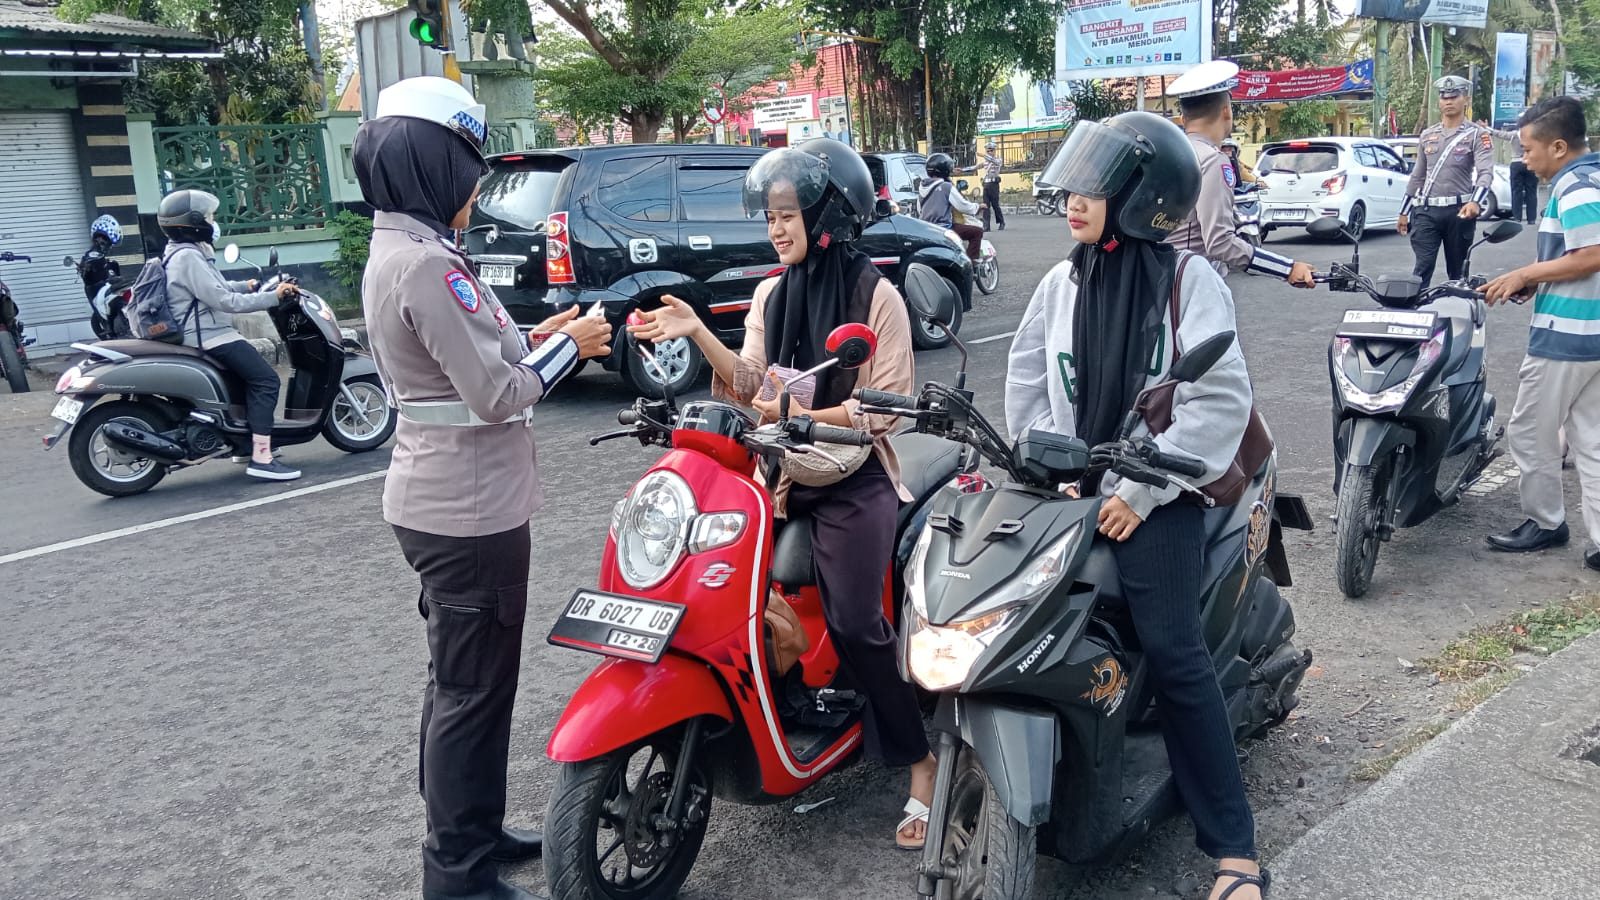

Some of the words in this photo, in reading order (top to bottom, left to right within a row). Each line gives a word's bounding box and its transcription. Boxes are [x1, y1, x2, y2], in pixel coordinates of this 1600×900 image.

[1082, 20, 1120, 33] BANGKIT
[1098, 25, 1143, 39] BERSAMA!
[1091, 38, 1109, 48] NTB
[1111, 32, 1149, 45] MAKMUR
[1128, 35, 1172, 49] MENDUNIA
[726, 270, 743, 278] TRD
[940, 569, 971, 580] HONDA
[571, 597, 595, 617] DR
[599, 602, 643, 625] 6027
[648, 610, 674, 631] UB
[1016, 633, 1056, 674] HONDA
